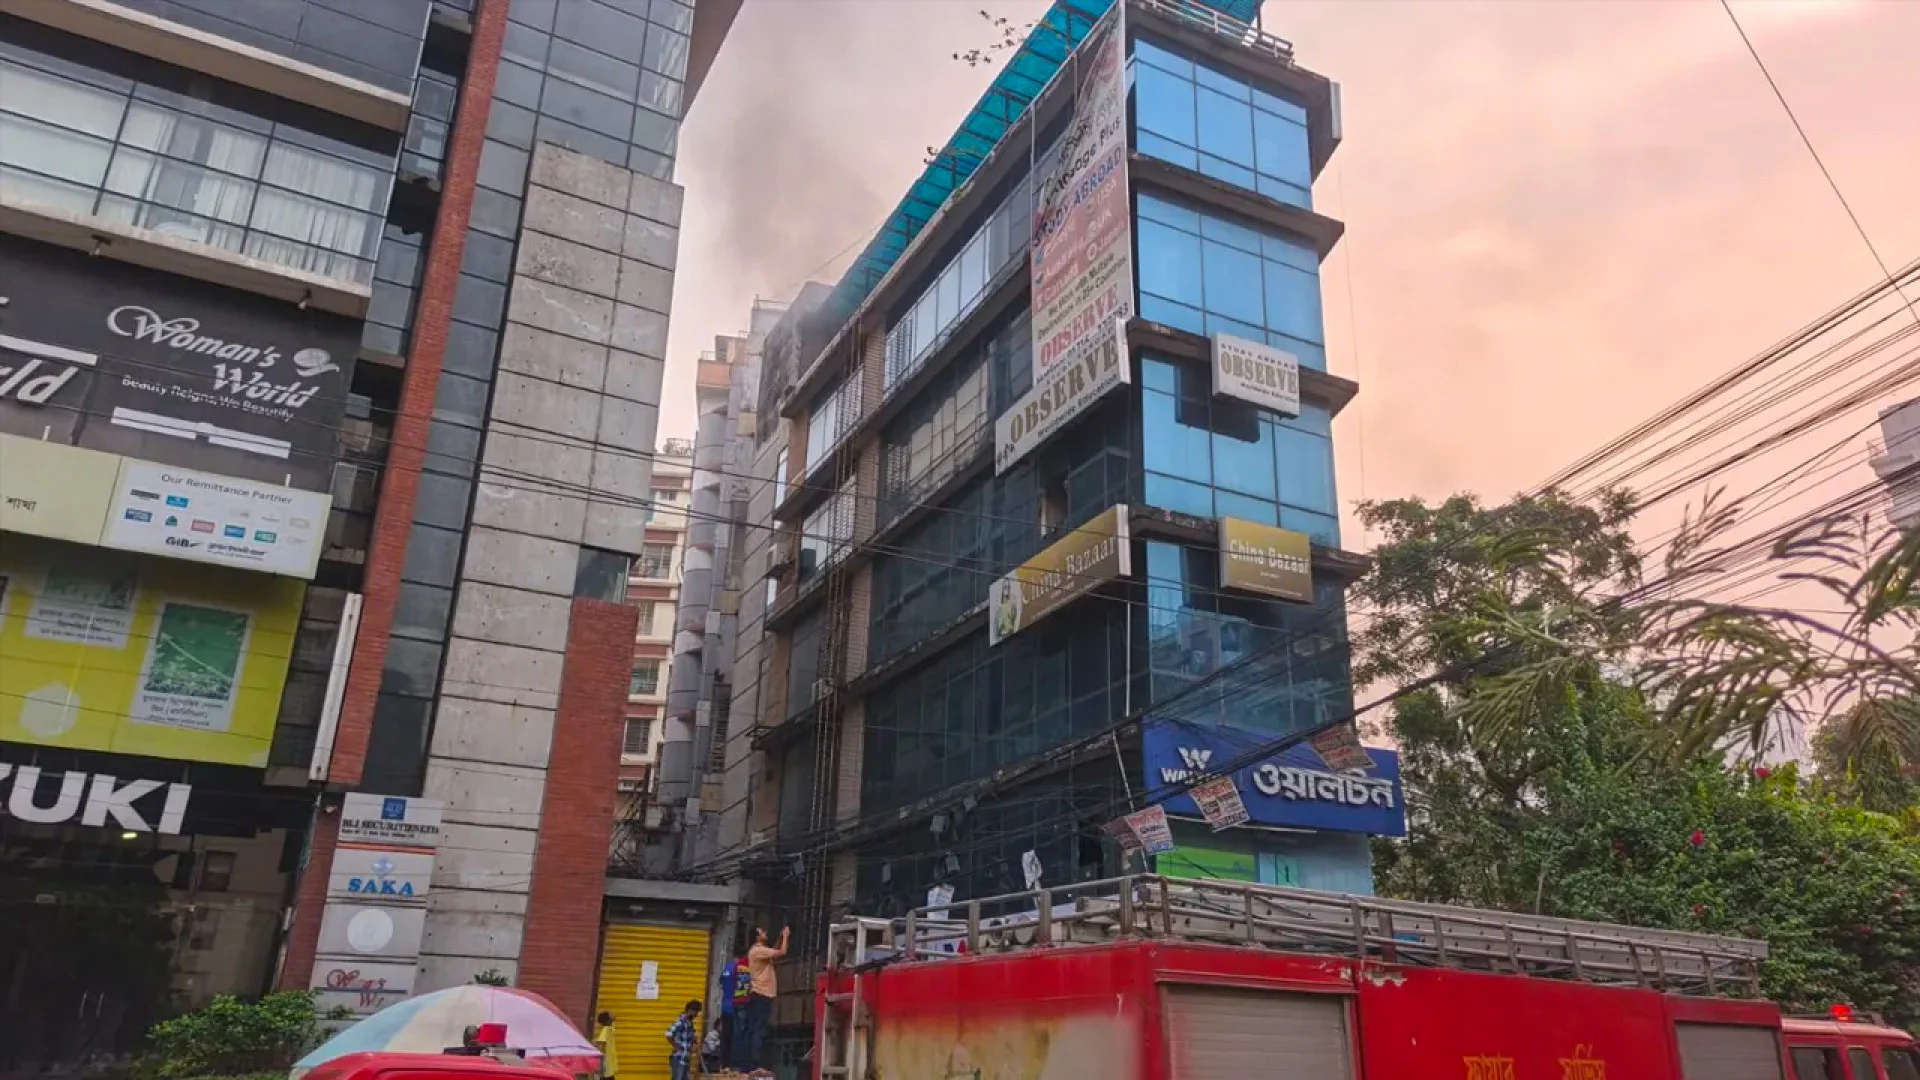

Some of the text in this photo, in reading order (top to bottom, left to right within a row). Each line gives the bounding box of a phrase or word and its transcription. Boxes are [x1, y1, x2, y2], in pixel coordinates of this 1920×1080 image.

[107, 306, 282, 368] Woman's
[1041, 281, 1117, 367] OBSERVE
[212, 363, 320, 408] World
[1010, 338, 1118, 444] OBSERVE
[1220, 351, 1297, 394] OBSERVE
[161, 473, 294, 505] Our Remittance Partner
[1064, 536, 1114, 579] Bazaar
[1229, 539, 1309, 574] China Bazaar
[348, 878, 414, 897] SAKA
